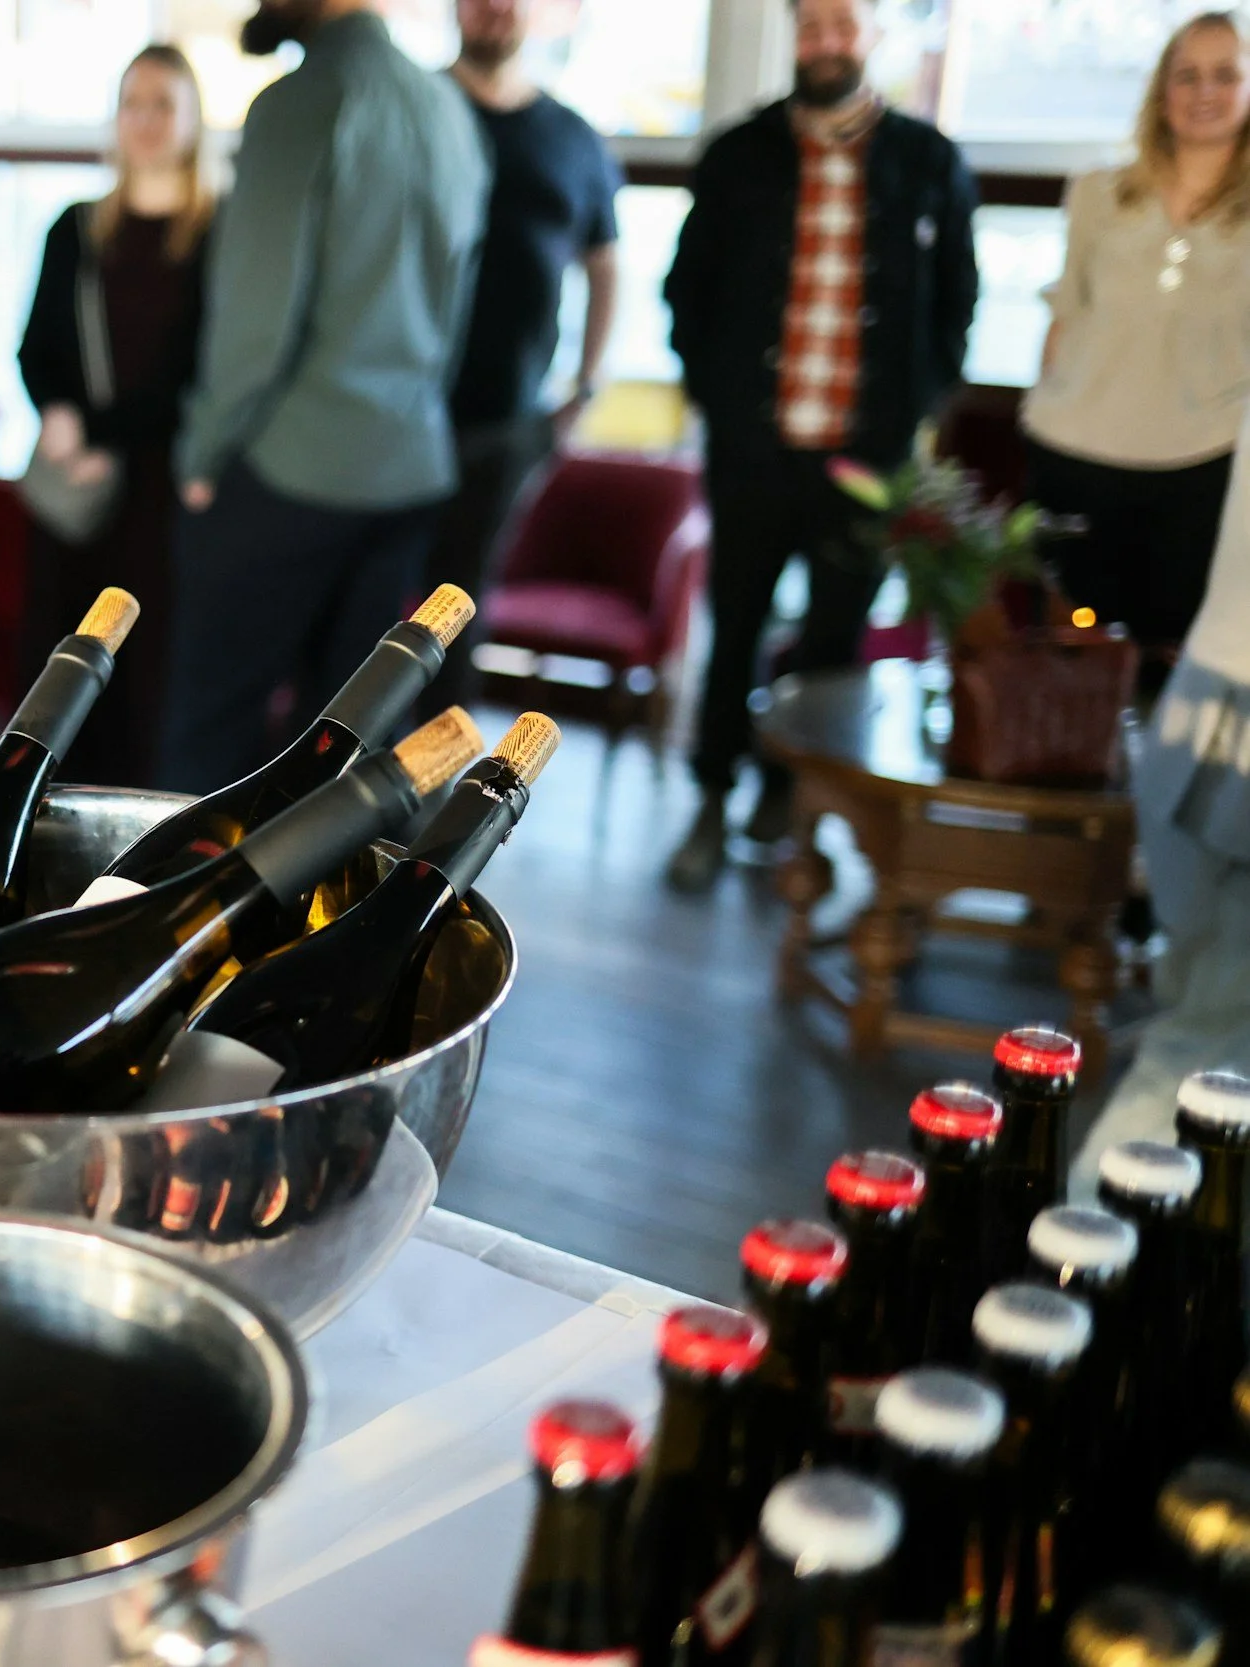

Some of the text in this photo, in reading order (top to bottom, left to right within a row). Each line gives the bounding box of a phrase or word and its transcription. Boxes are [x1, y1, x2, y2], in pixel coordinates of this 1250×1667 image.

[521, 722, 547, 756] BOUTEILLE
[526, 750, 537, 764] NOS
[536, 729, 552, 751] CAVES
